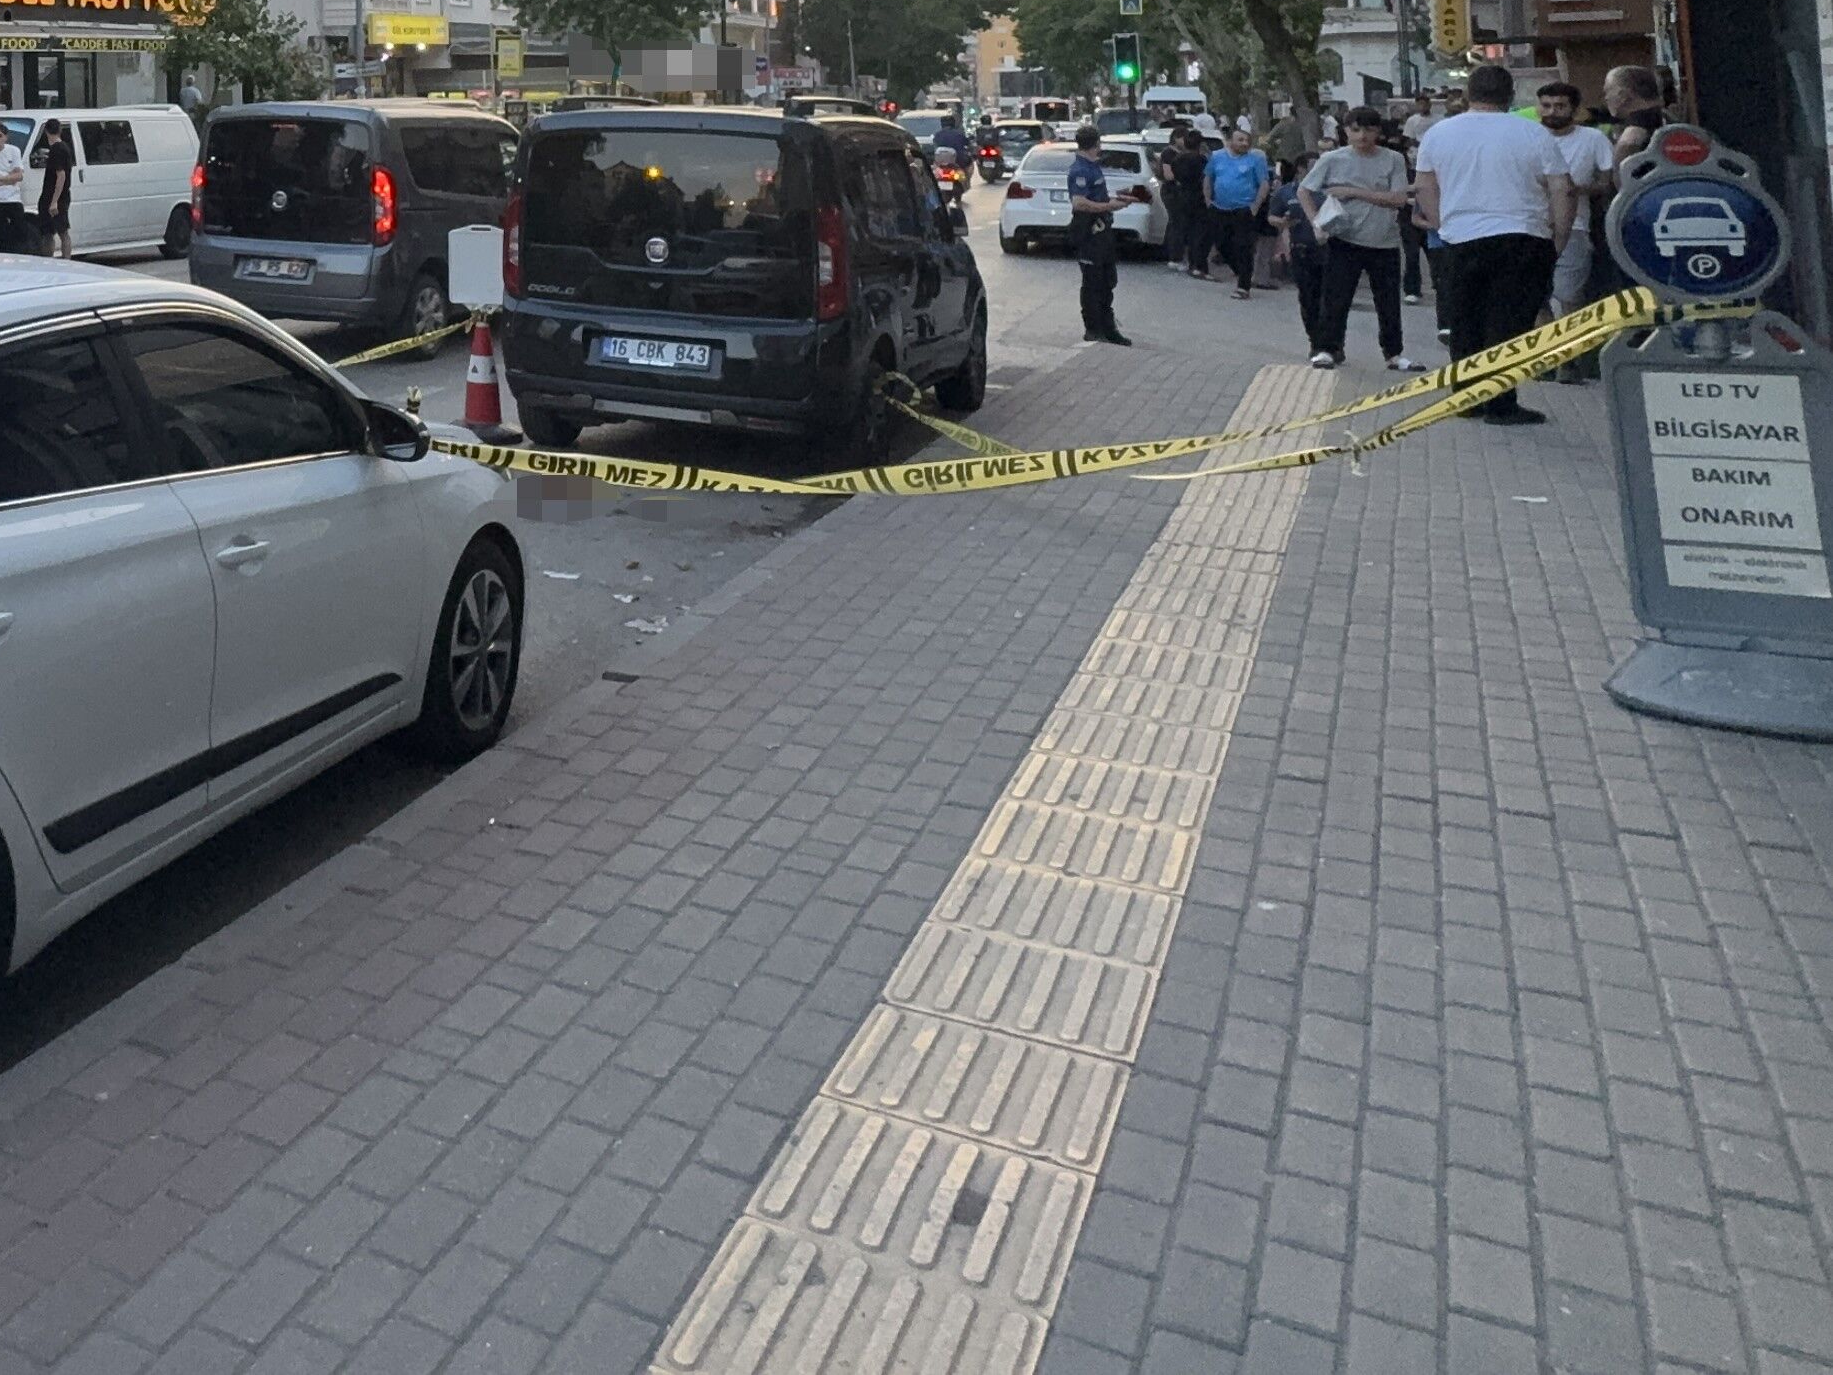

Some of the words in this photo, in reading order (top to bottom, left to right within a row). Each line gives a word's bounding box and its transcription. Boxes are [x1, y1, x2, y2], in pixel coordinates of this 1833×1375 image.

[1, 36, 37, 50] FOOD
[67, 37, 109, 51] CADDEE
[111, 38, 136, 51] FAST
[138, 38, 167, 51] FOOD
[611, 338, 627, 356] 16
[637, 341, 666, 360] CBK
[675, 344, 707, 363] 843
[1681, 383, 1723, 399] LED
[1730, 384, 1760, 399] TV
[1654, 417, 1800, 443] BİLGİSAYAR
[1692, 467, 1771, 486] BAKIM
[1681, 506, 1794, 529] ONARIM
